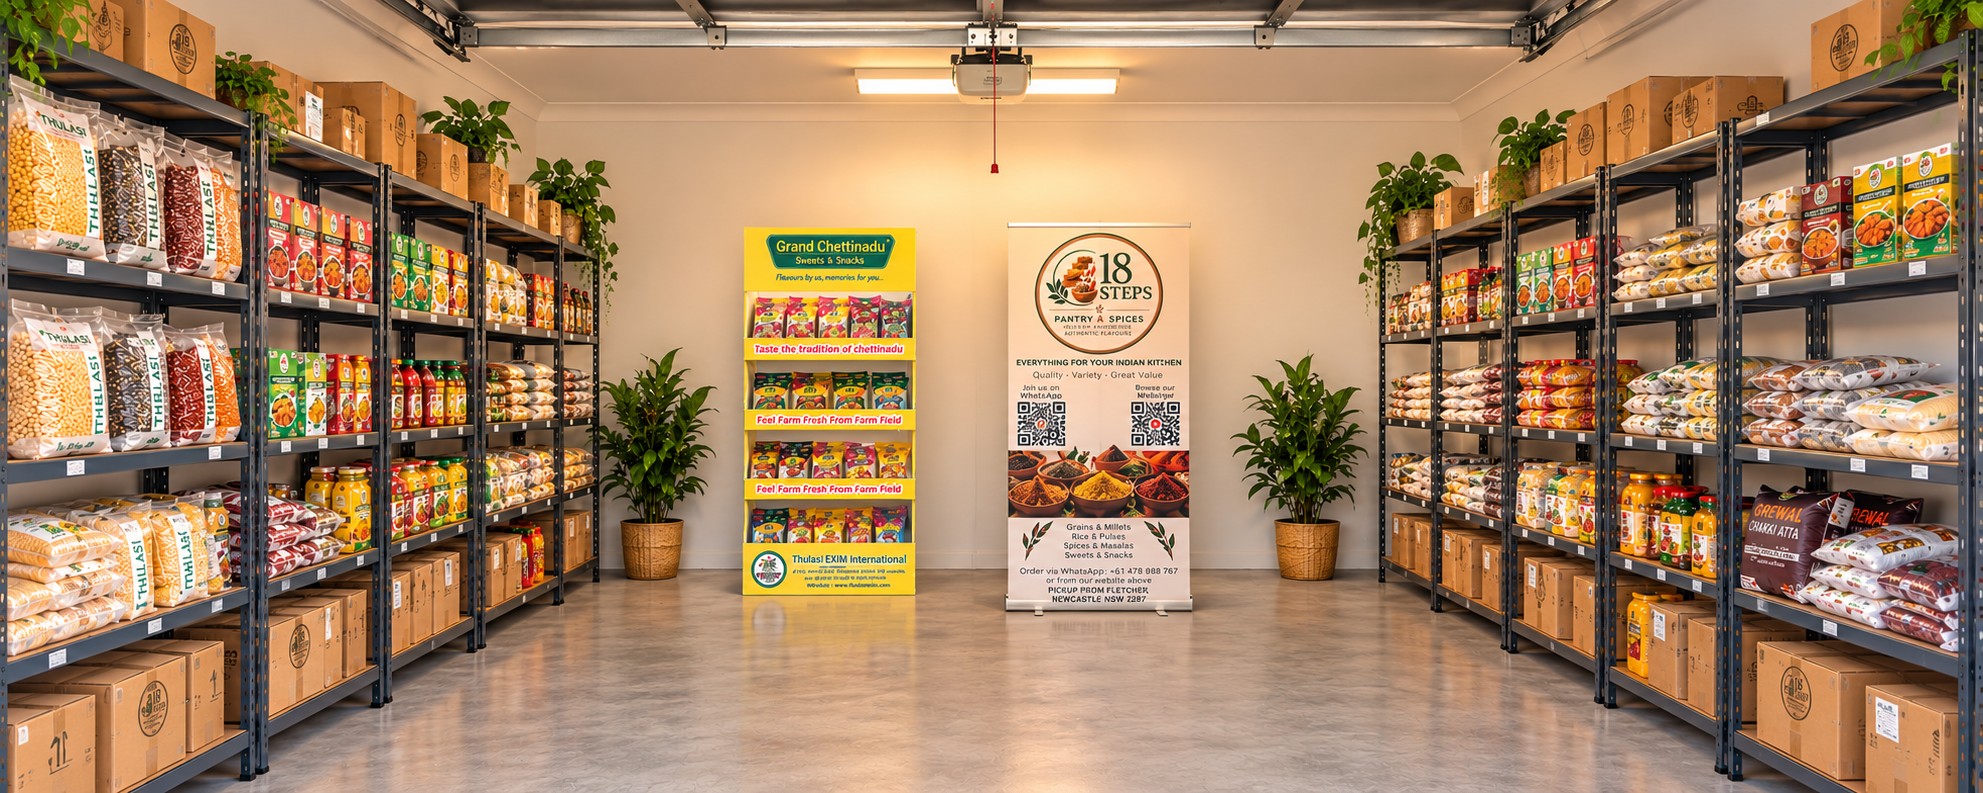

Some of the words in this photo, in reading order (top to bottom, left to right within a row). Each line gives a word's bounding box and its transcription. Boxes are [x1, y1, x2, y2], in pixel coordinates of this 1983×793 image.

[40, 114, 87, 137] THULASI
[776, 240, 814, 252] Grand
[817, 240, 886, 252] Chettinadu
[1099, 252, 1133, 284] 18
[1100, 286, 1152, 300] STEPS
[755, 345, 779, 354] Taste
[781, 345, 796, 354] the
[799, 345, 839, 354] tradition
[842, 345, 852, 354] of
[854, 345, 903, 354] chettinadu
[1033, 371, 1063, 380] Quality
[1072, 371, 1102, 380] Variety
[778, 416, 800, 424] Farm
[803, 416, 827, 424] Fresh
[830, 416, 852, 424] From
[855, 416, 877, 424] Farm
[880, 416, 901, 424] Field
[1754, 503, 1802, 523] GREWAL
[1777, 526, 1799, 540] ATTA
[825, 555, 848, 564] EXIM
[850, 555, 907, 564] International
[1061, 568, 1107, 576] WhatsApp:
